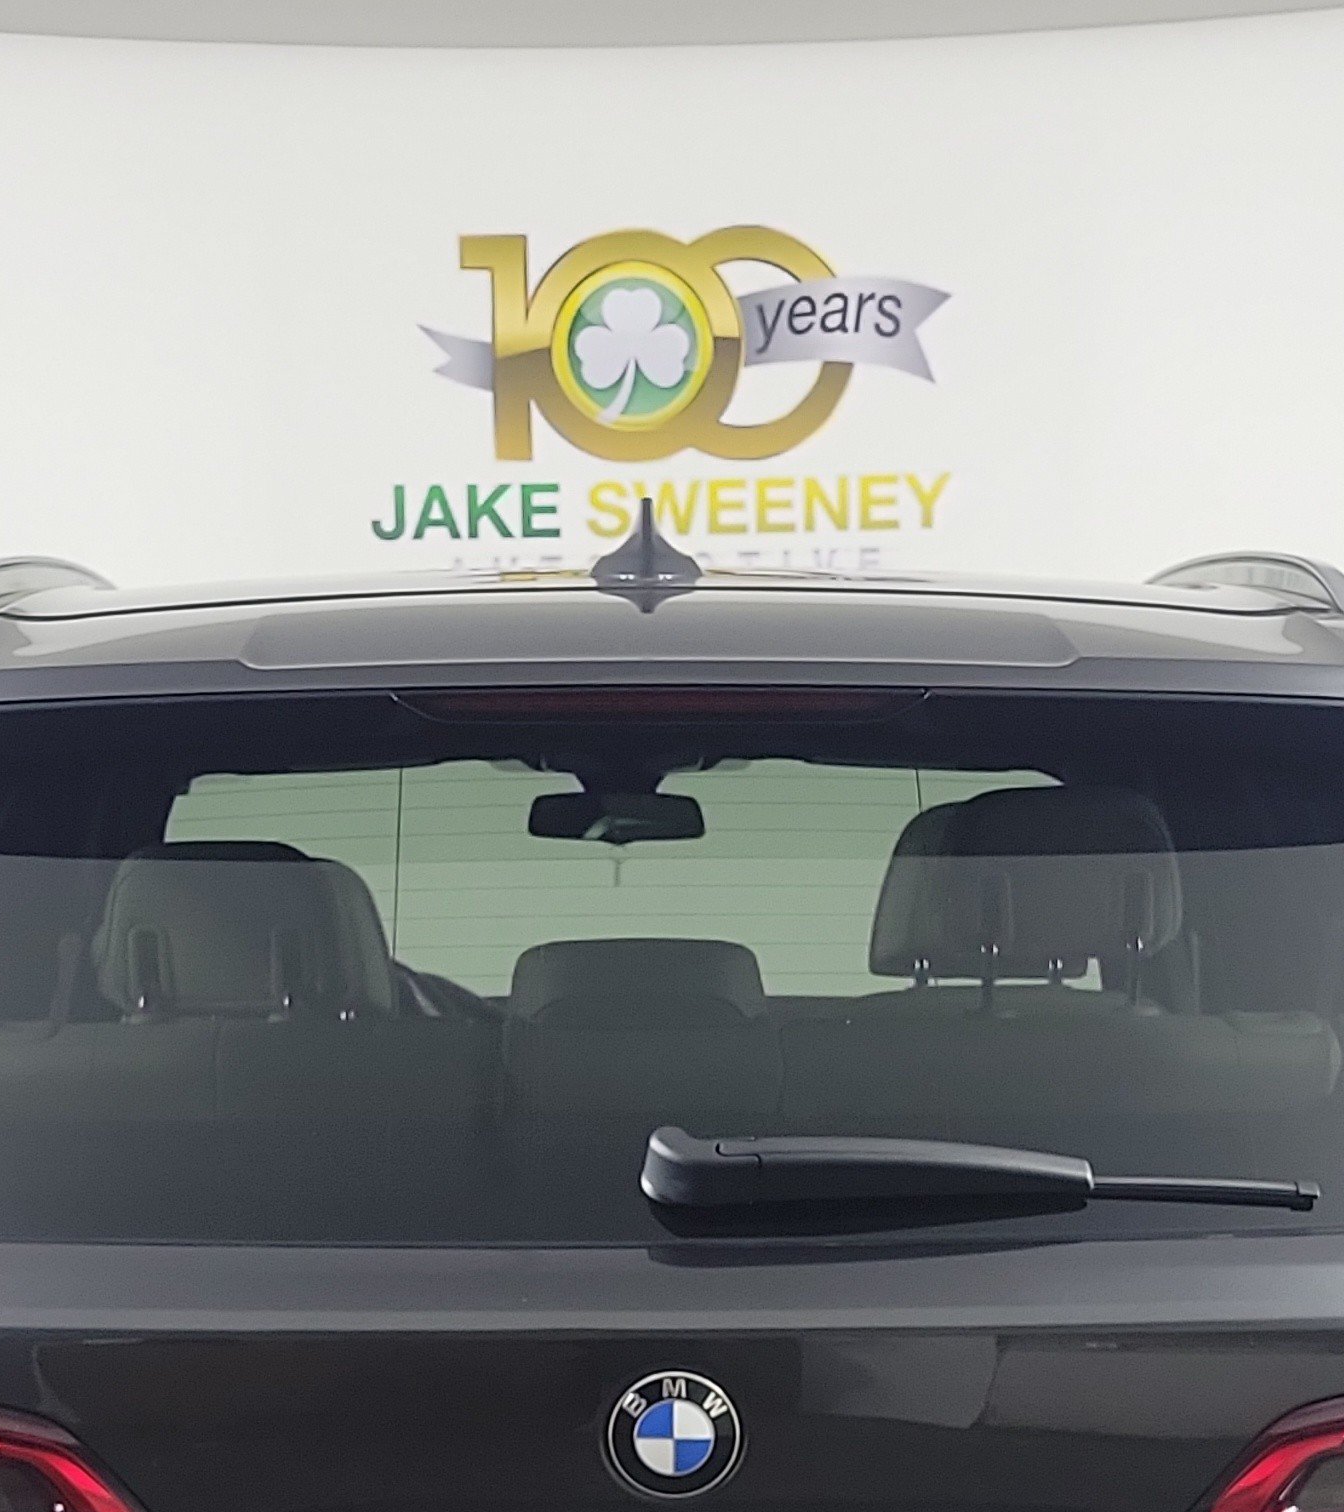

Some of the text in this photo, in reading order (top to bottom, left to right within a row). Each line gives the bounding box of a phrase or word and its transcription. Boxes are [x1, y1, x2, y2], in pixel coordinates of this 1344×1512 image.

[753, 289, 903, 354] years
[370, 472, 950, 541] JAKE SWEENEY
[621, 1377, 729, 1419] BMW
